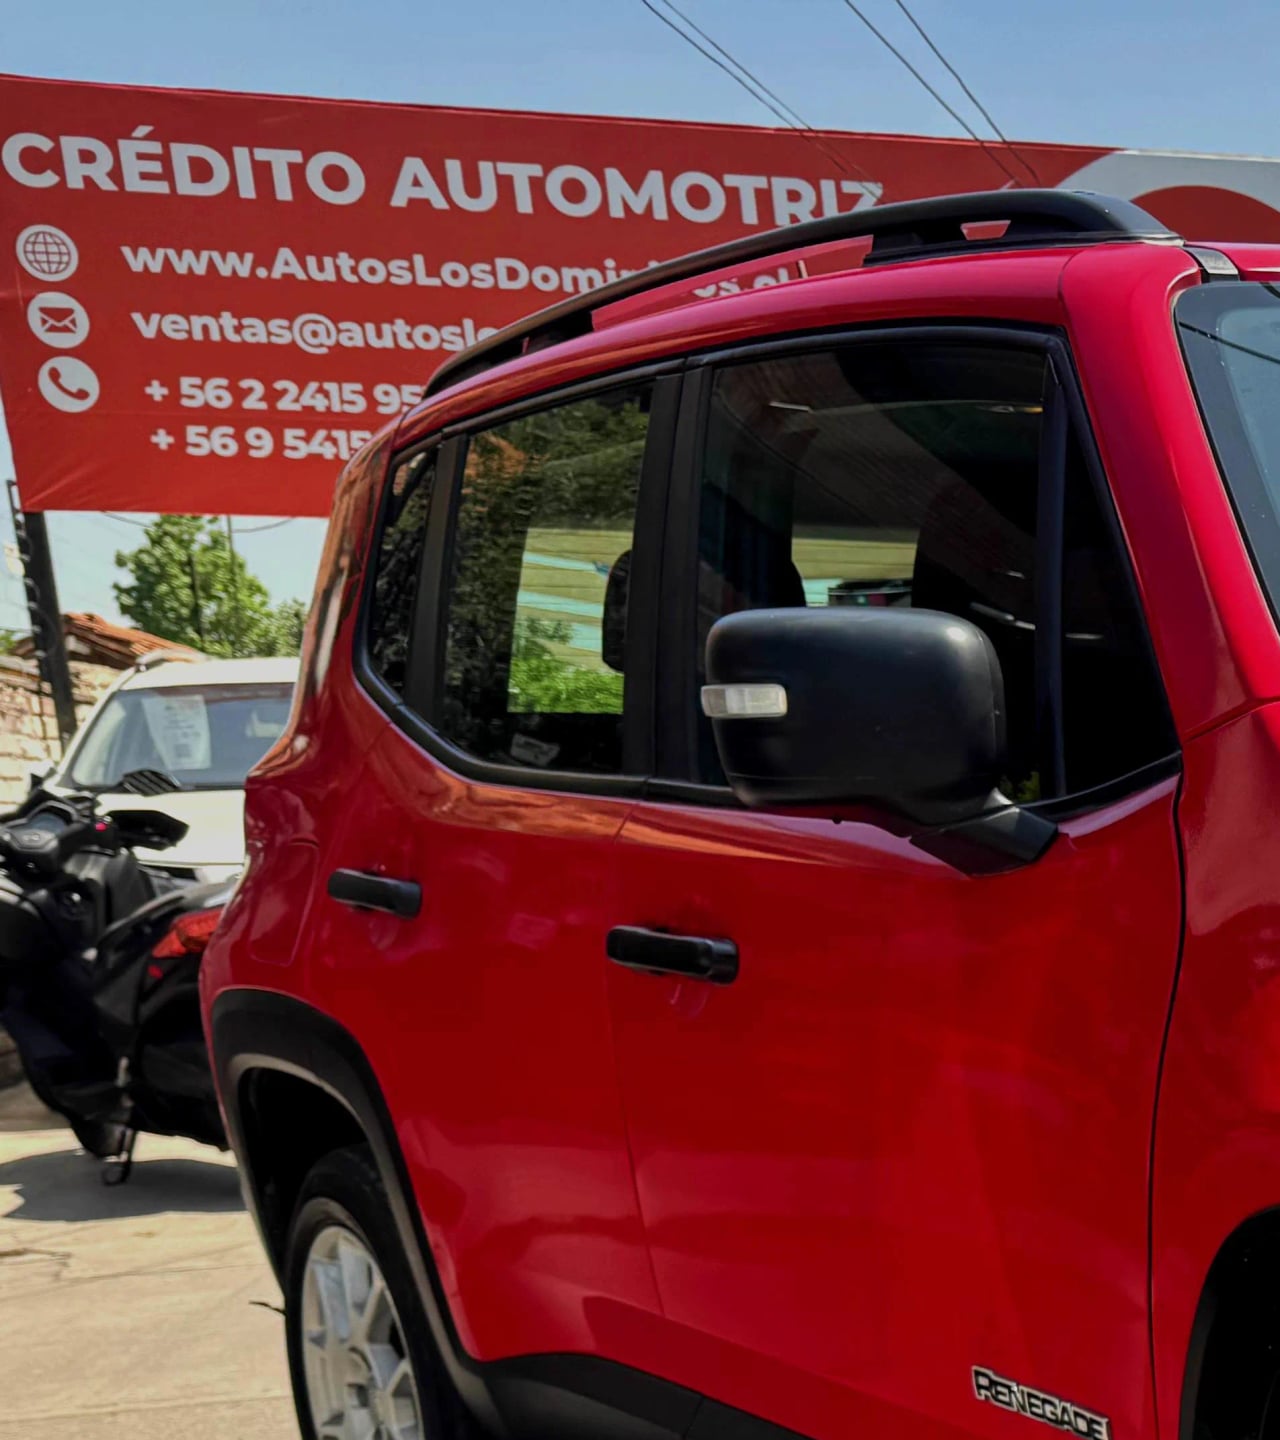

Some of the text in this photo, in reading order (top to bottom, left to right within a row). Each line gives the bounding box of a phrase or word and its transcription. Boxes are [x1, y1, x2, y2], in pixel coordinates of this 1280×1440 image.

[1, 125, 366, 206] CRÉDITO
[179, 376, 233, 409] 56
[239, 379, 268, 410] 2
[272, 380, 367, 414] 2415
[185, 425, 239, 457] 56
[244, 427, 274, 458] 9
